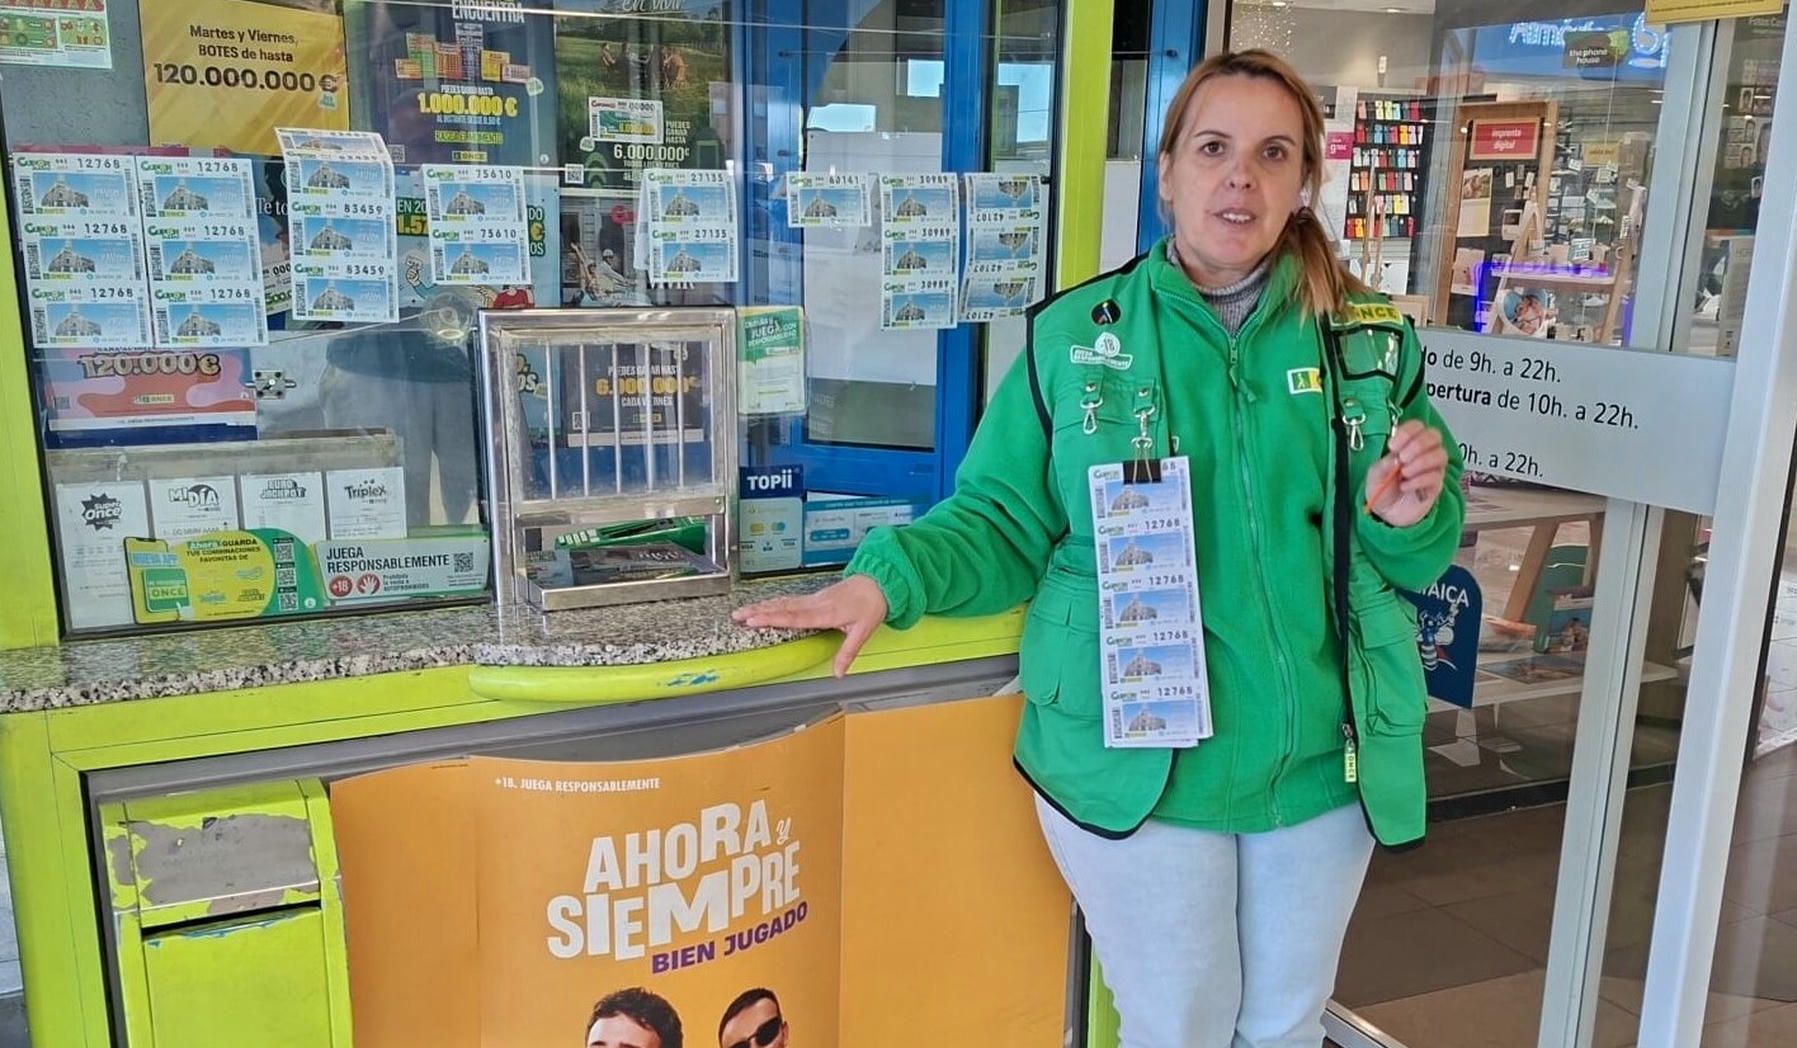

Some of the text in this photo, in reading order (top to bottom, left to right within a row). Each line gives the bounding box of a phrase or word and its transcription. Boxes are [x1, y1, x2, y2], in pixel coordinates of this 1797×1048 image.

[190, 25, 299, 46] Martes y Viernes,
[198, 44, 294, 63] BOTES de hasta
[154, 63, 341, 94] 120.000.000 €
[417, 92, 518, 118] 1.000.000 €
[1493, 140, 1515, 151] digital
[78, 158, 120, 169] 12768
[197, 162, 239, 172] 12768
[475, 169, 512, 179] 75610
[690, 172, 724, 182] 27135
[343, 203, 383, 214] 83459
[397, 200, 413, 213] EN
[976, 213, 1005, 223] 42107
[84, 223, 128, 235] 12768
[204, 225, 245, 236] 12768
[480, 229, 517, 239] 75610
[695, 229, 727, 239] 27135
[973, 264, 1003, 274] 42107
[90, 288, 134, 298] 12768
[210, 288, 251, 299] 12768
[80, 352, 221, 379] 120.000 €
[1442, 348, 1465, 371] de
[1470, 352, 1497, 375] 9h.
[1503, 362, 1514, 376] a
[1520, 358, 1561, 383] 22h.
[1497, 388, 1520, 411] de
[1528, 392, 1568, 419] 10h.
[1575, 405, 1587, 421] a
[1594, 402, 1639, 430] 22h.
[1488, 453, 1499, 469] a
[1505, 451, 1544, 478] 22h.
[1145, 519, 1180, 530] 12768
[222, 539, 258, 547] GUARDA
[326, 547, 364, 561] JUEGA
[327, 554, 450, 574] RESPONSABLEMENTE
[1148, 574, 1185, 586] 12768
[151, 587, 185, 598] ONCE
[1153, 630, 1189, 641] 12768
[1157, 686, 1193, 697] 12768
[520, 778, 553, 791] JUEGA
[555, 778, 660, 793] RESPONSABLEMENTE
[583, 799, 772, 894] AHORA
[546, 840, 800, 961] SIEMPRE
[651, 901, 808, 975] BIEN JUGADO
